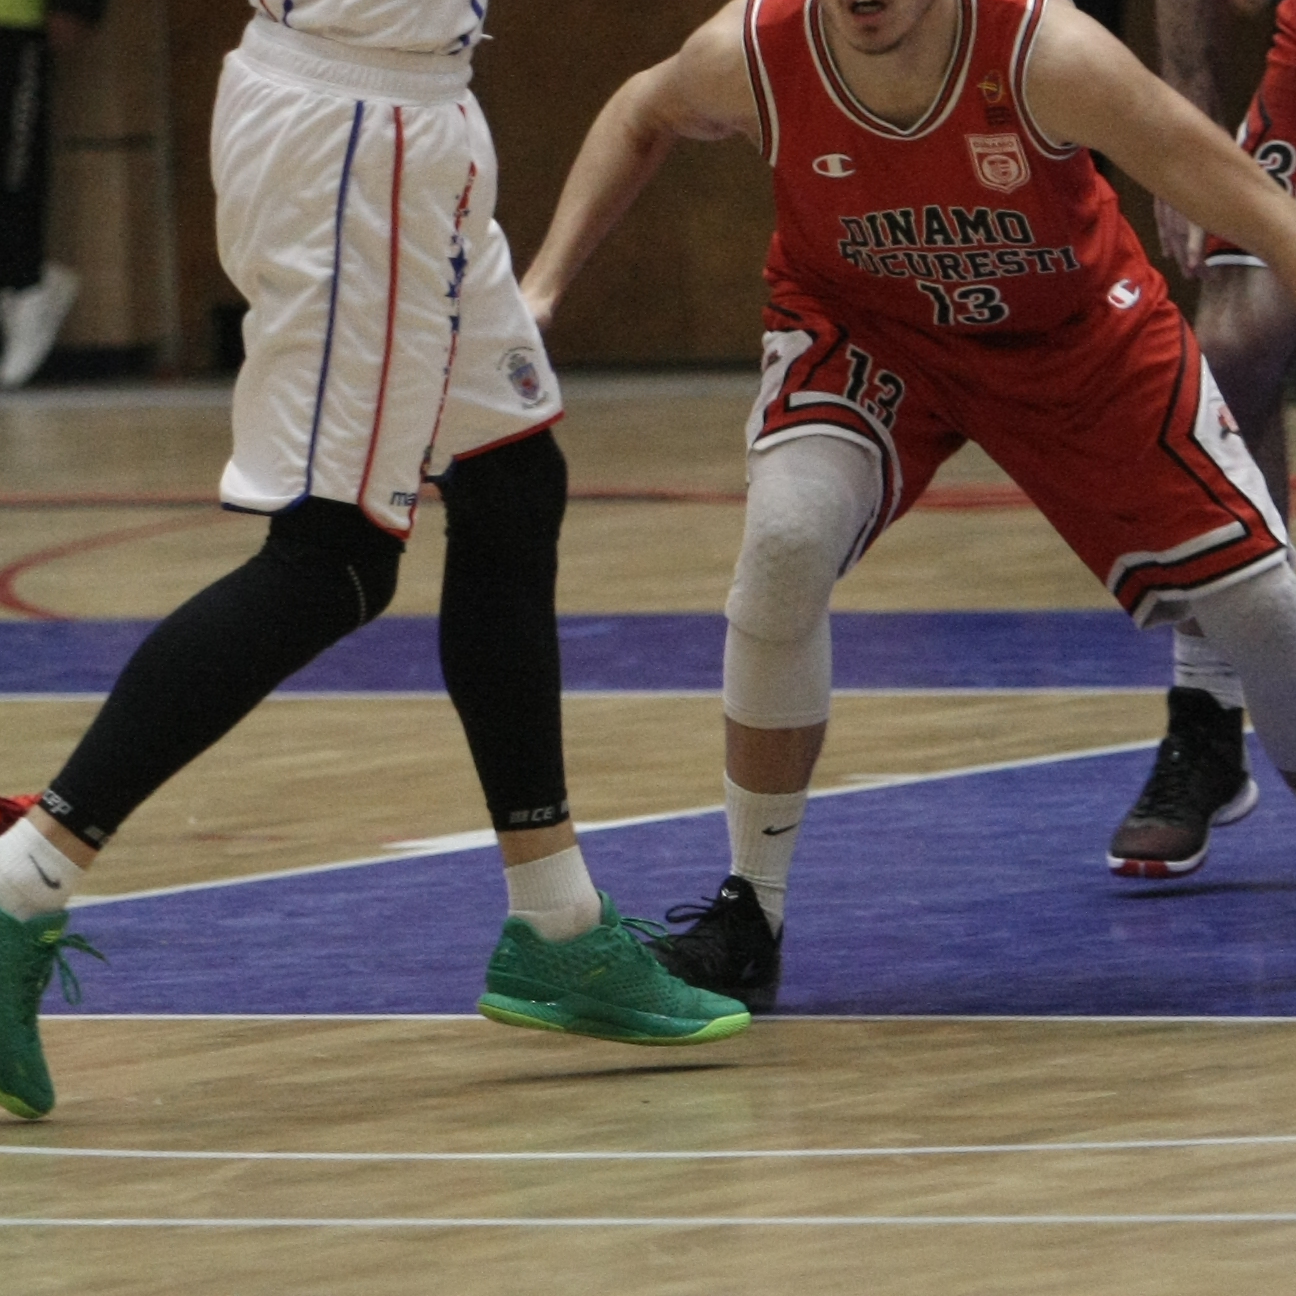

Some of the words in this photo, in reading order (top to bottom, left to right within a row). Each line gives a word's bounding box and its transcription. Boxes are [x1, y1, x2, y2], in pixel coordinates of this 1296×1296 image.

[839, 204, 1035, 250] DINAMO
[916, 278, 1010, 326] 13
[843, 343, 906, 432] 13
